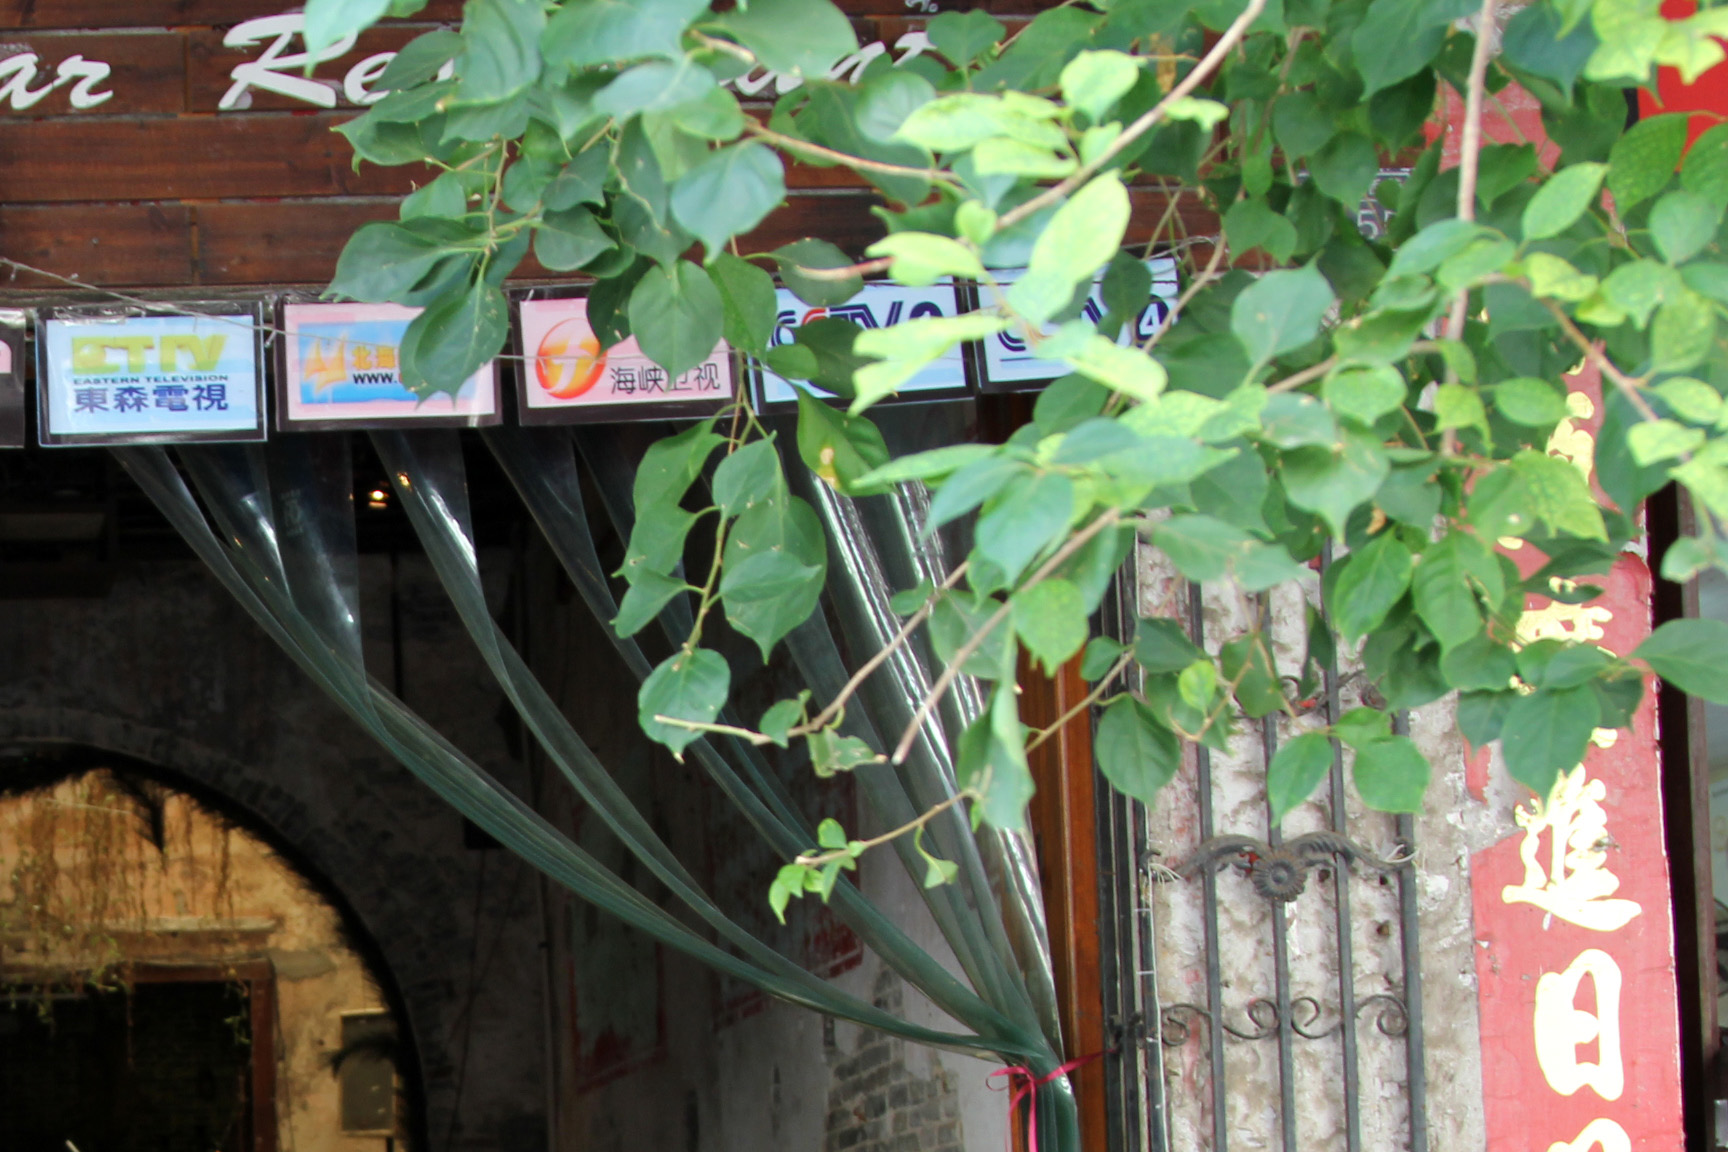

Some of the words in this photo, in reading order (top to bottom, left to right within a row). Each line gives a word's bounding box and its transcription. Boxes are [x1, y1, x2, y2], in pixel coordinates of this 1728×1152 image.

[73, 377, 140, 385] EASTERN
[146, 375, 229, 383] TELEVISION
[610, 362, 721, 396] 海峡卫视
[73, 384, 229, 414] 東森電視
